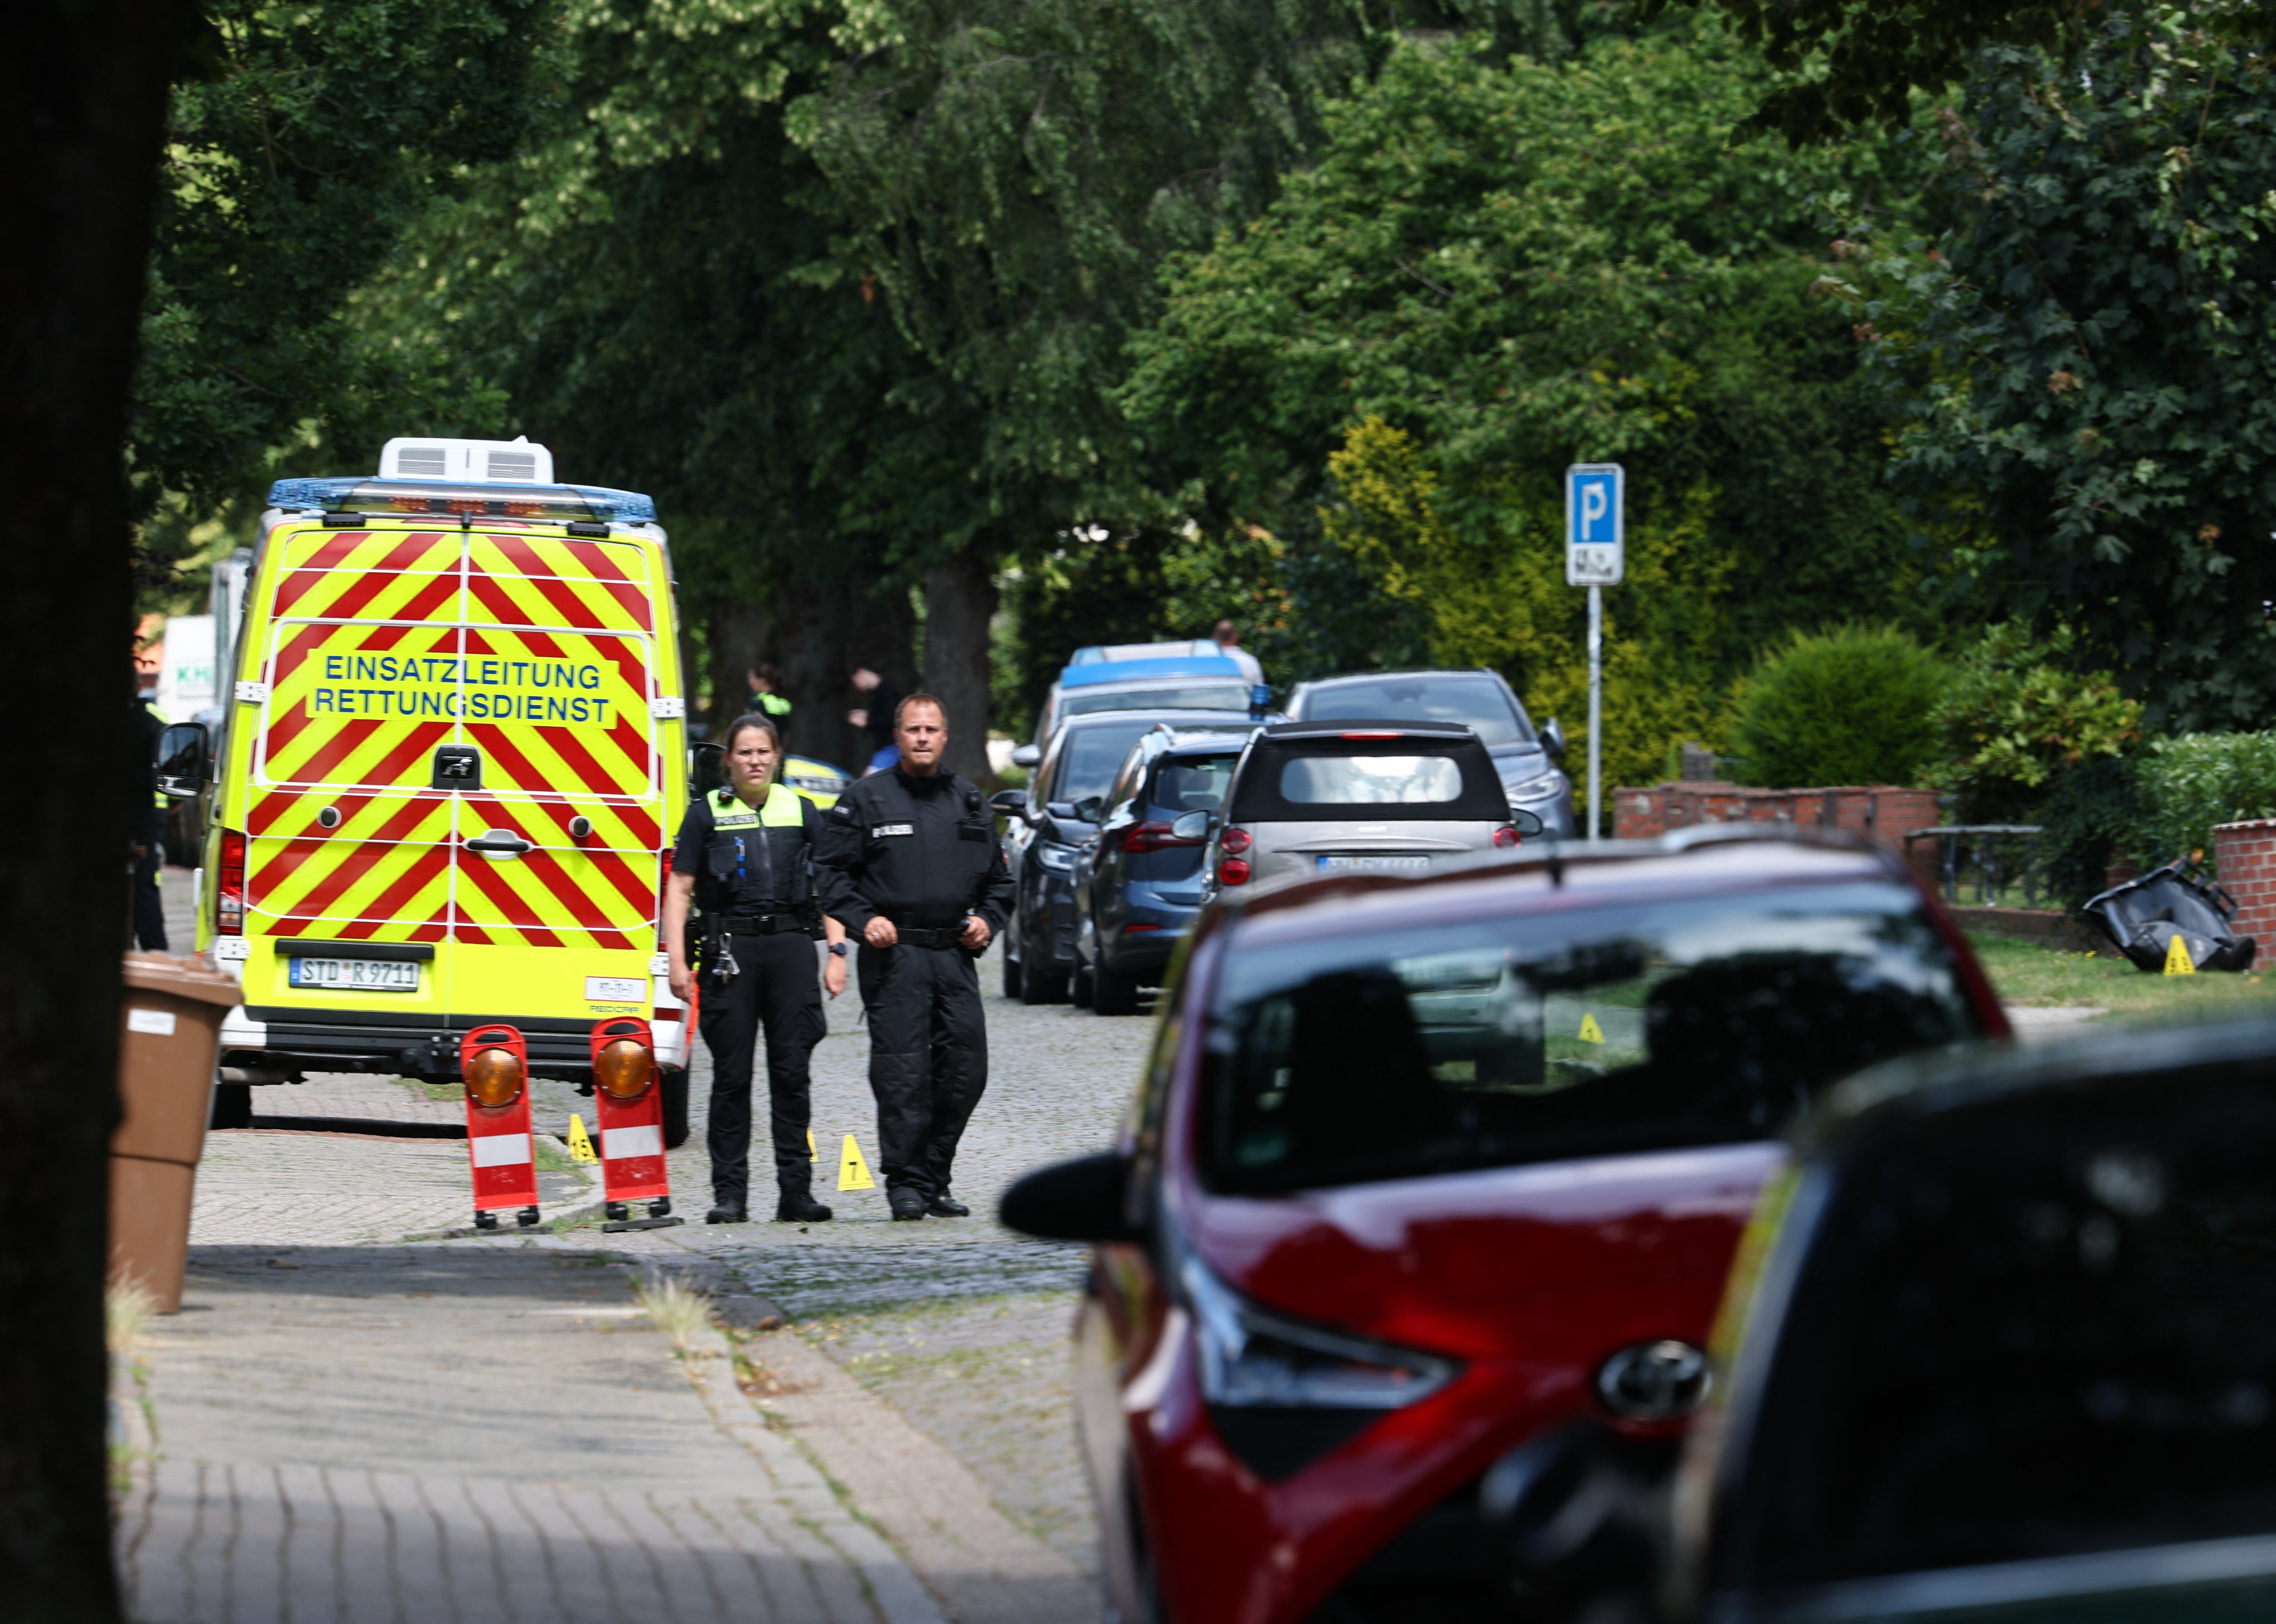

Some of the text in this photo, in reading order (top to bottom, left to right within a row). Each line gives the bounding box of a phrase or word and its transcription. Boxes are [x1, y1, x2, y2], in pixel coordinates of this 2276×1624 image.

[1582, 483, 1607, 541] P
[326, 655, 600, 689] EINSATZLEITUNG
[315, 688, 609, 723] RETTUNGSDIENST
[303, 961, 338, 981] STD
[353, 962, 364, 982] R
[371, 963, 417, 984] 9711
[848, 1161, 857, 1182] 7
